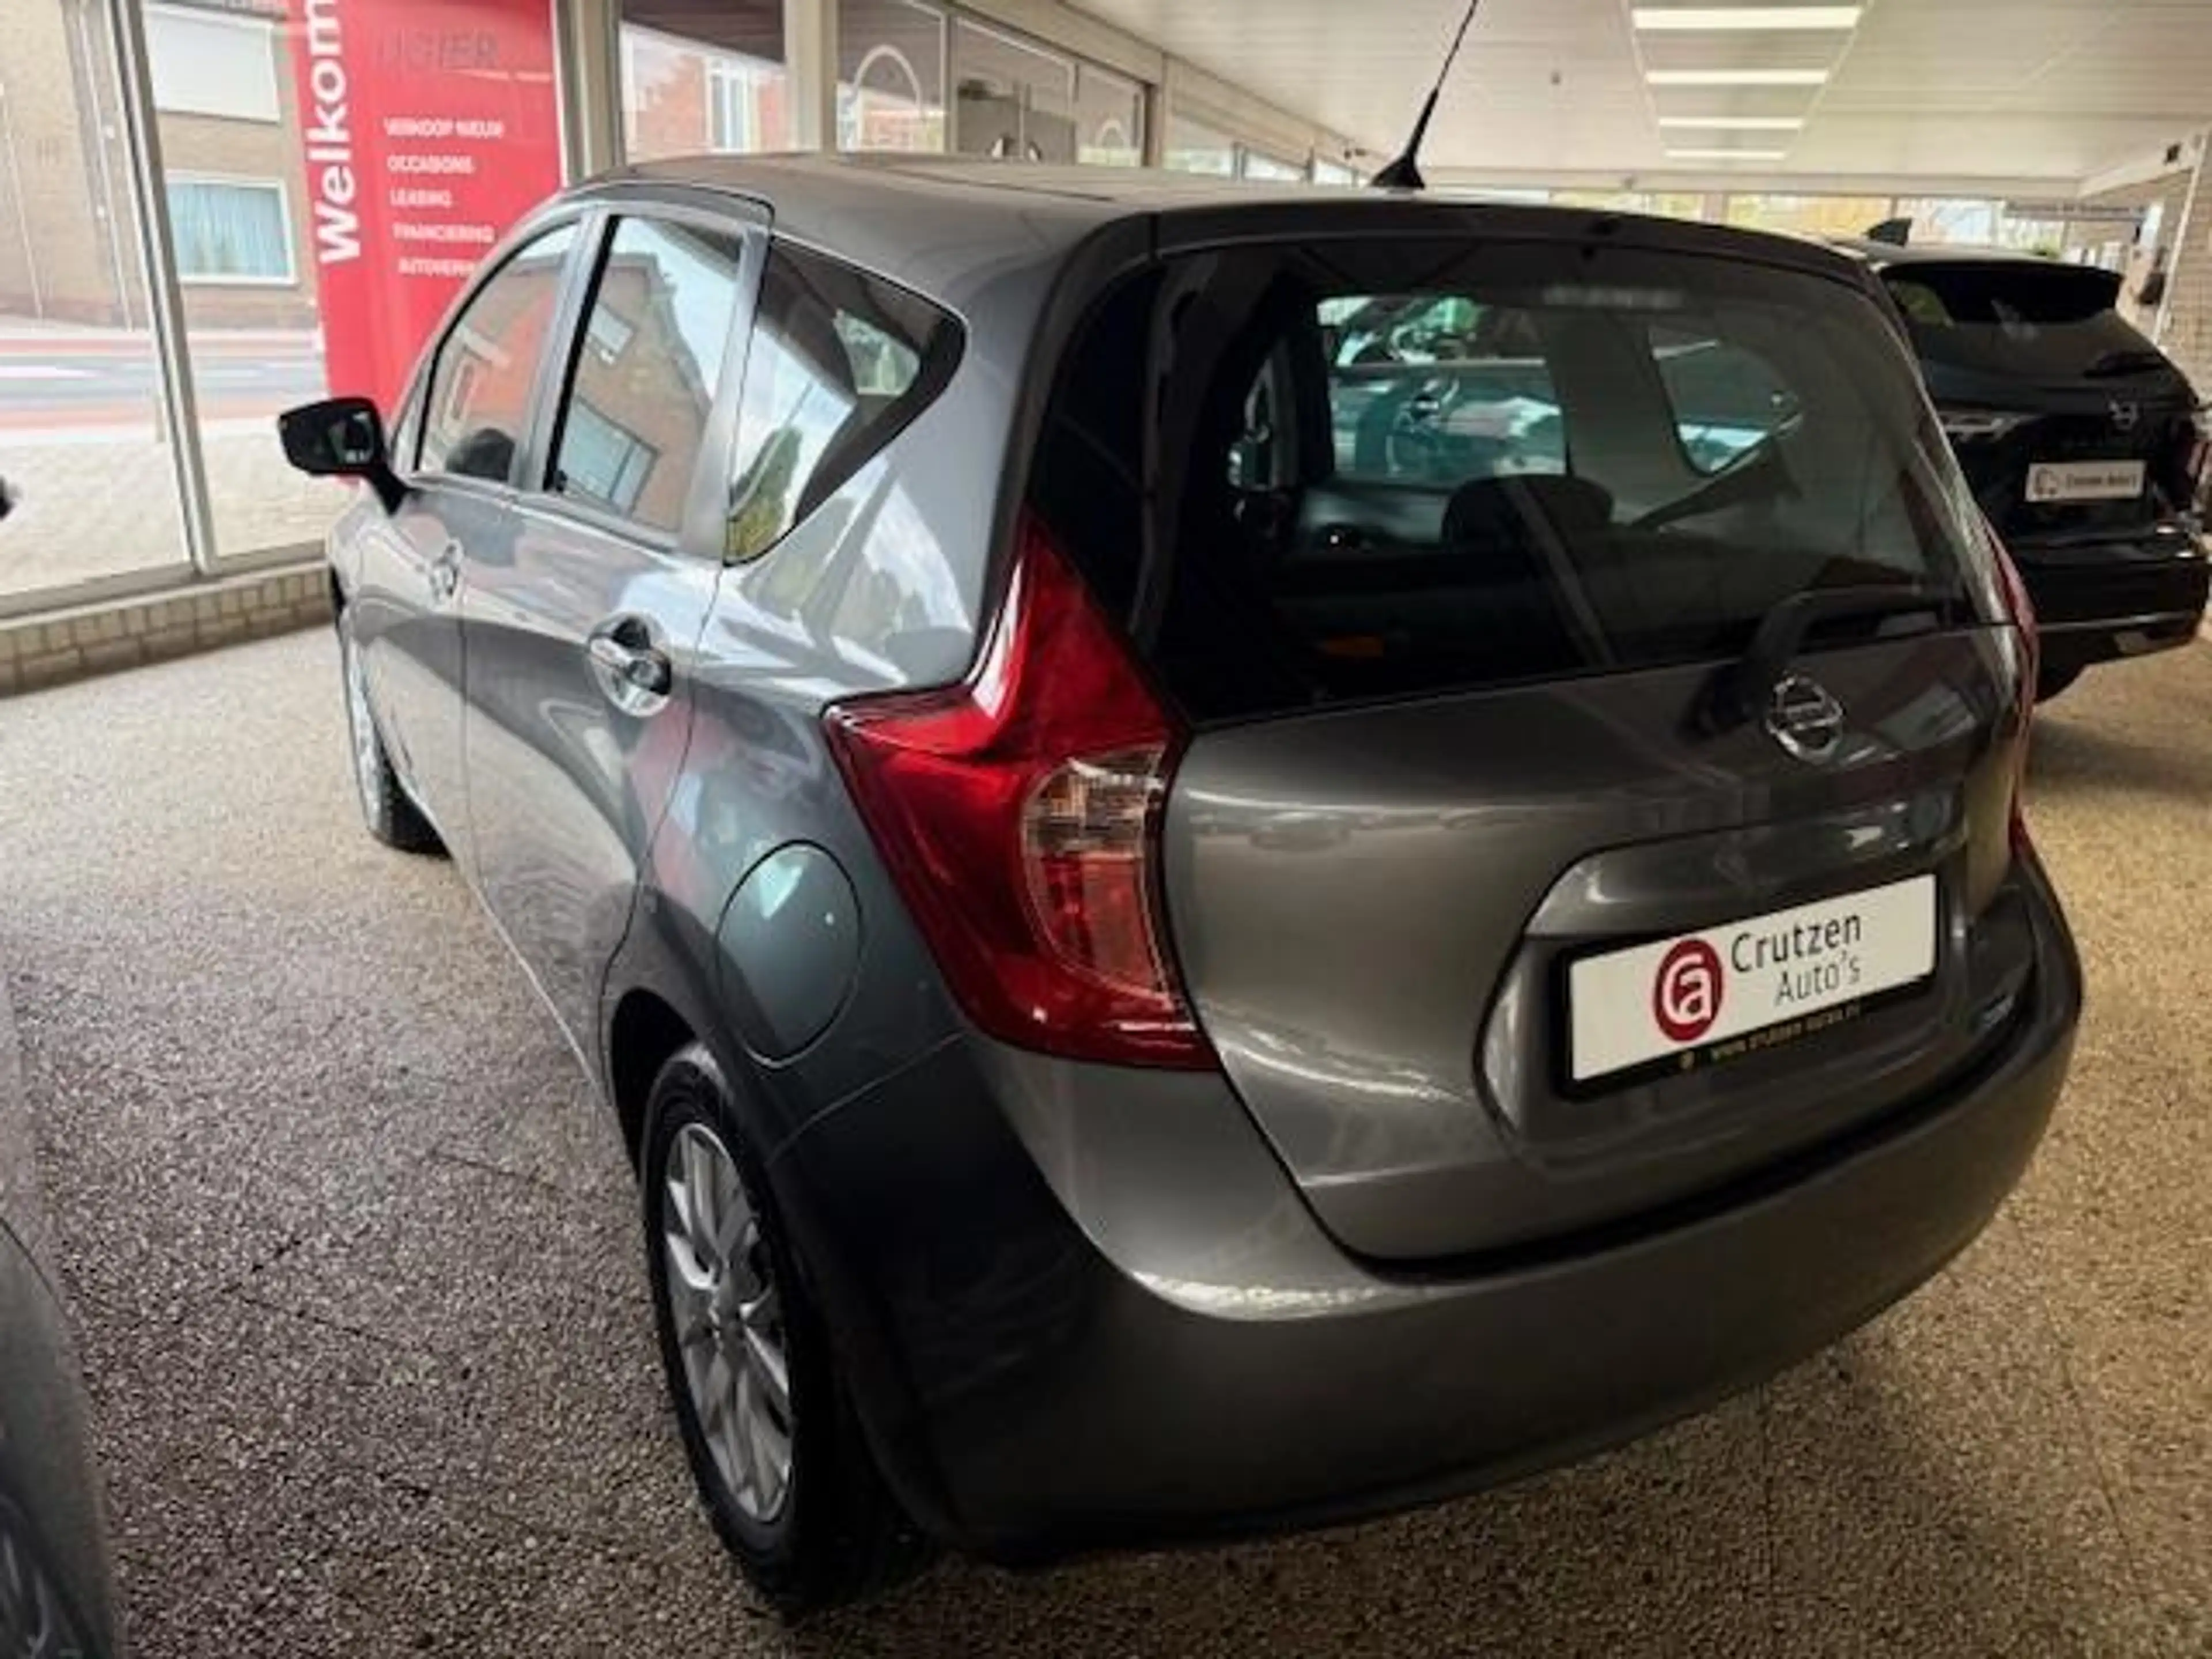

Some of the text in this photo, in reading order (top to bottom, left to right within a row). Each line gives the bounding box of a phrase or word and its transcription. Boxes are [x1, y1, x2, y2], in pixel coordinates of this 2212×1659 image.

[305, 0, 361, 264] Welkom
[1732, 914, 1861, 974] Crutzen
[1773, 949, 1861, 1006] Auto's
